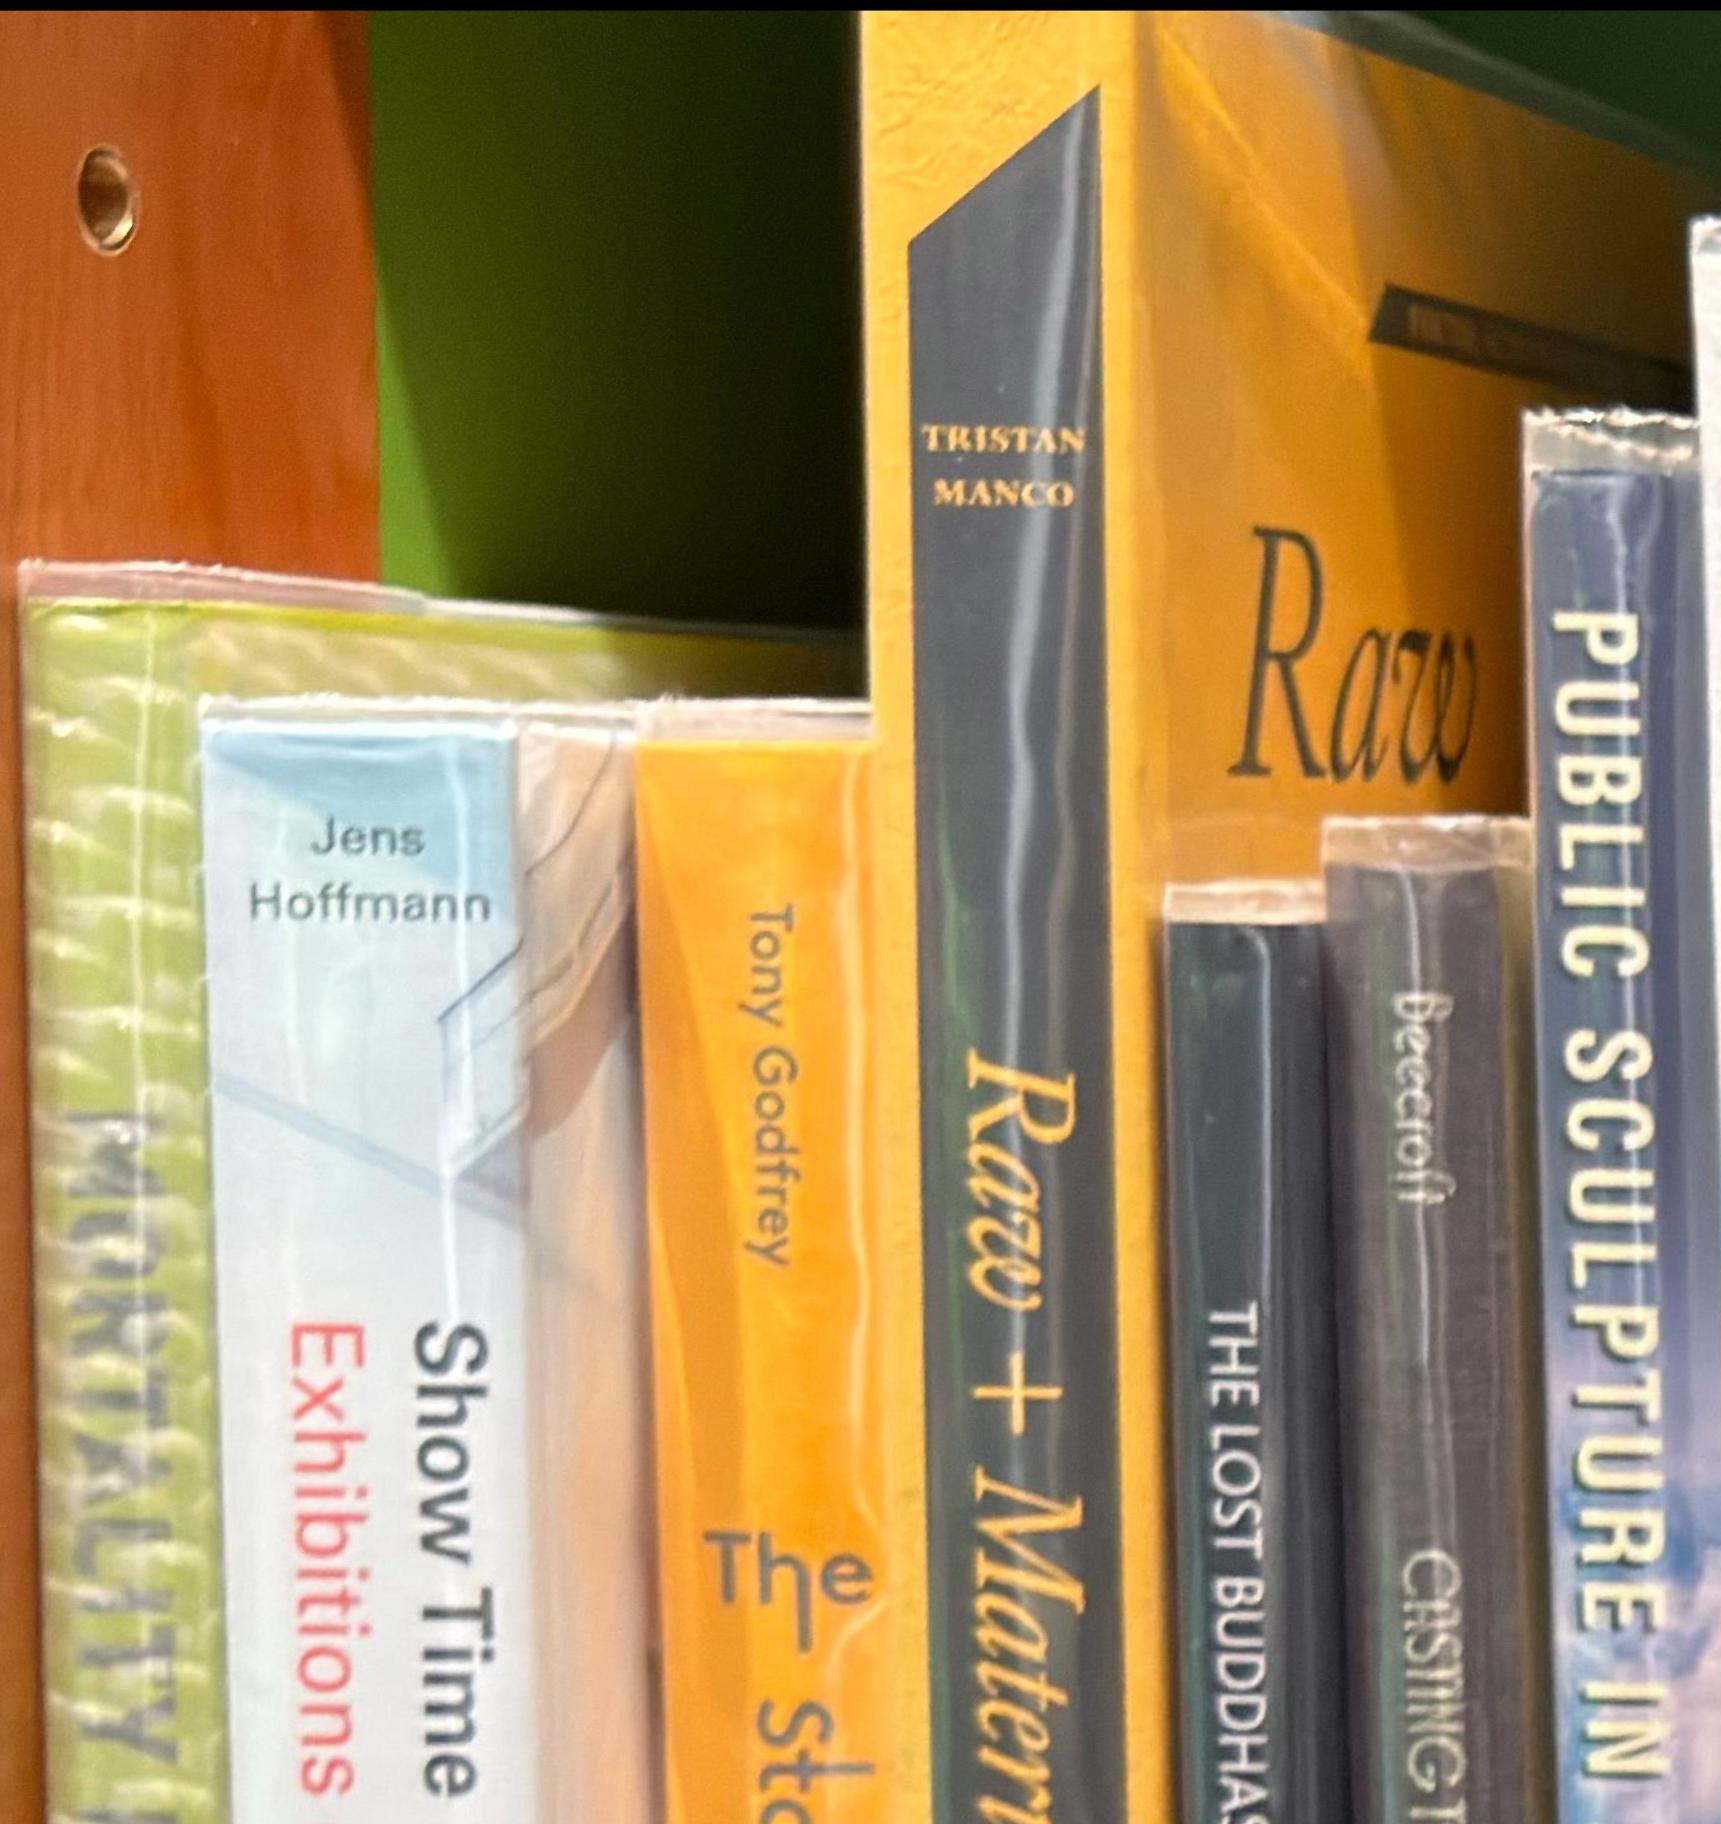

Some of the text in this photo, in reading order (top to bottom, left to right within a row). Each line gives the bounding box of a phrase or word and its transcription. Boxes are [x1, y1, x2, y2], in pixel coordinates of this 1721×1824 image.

[921, 423, 1086, 457] TRISTAN
[932, 477, 1076, 510] MANCO
[1227, 525, 1479, 785] Raw
[249, 880, 492, 924] Hoffmann
[310, 816, 426, 858] Jens
[1552, 609, 1650, 982] PUBLIC
[740, 903, 803, 1269] Tony Godfrey
[966, 1045, 1077, 1314] Raw
[1207, 1300, 1261, 1408] THE
[1564, 1028, 1669, 1635] SCULPTURE
[414, 1320, 489, 1567] Show
[1209, 1422, 1264, 1562] LOST
[290, 1320, 372, 1797] Exhibitions
[702, 1529, 874, 1654] The
[420, 1586, 496, 1800] Time
[1400, 1548, 1469, 1794] CASTING
[1580, 1680, 1672, 1782] IN
